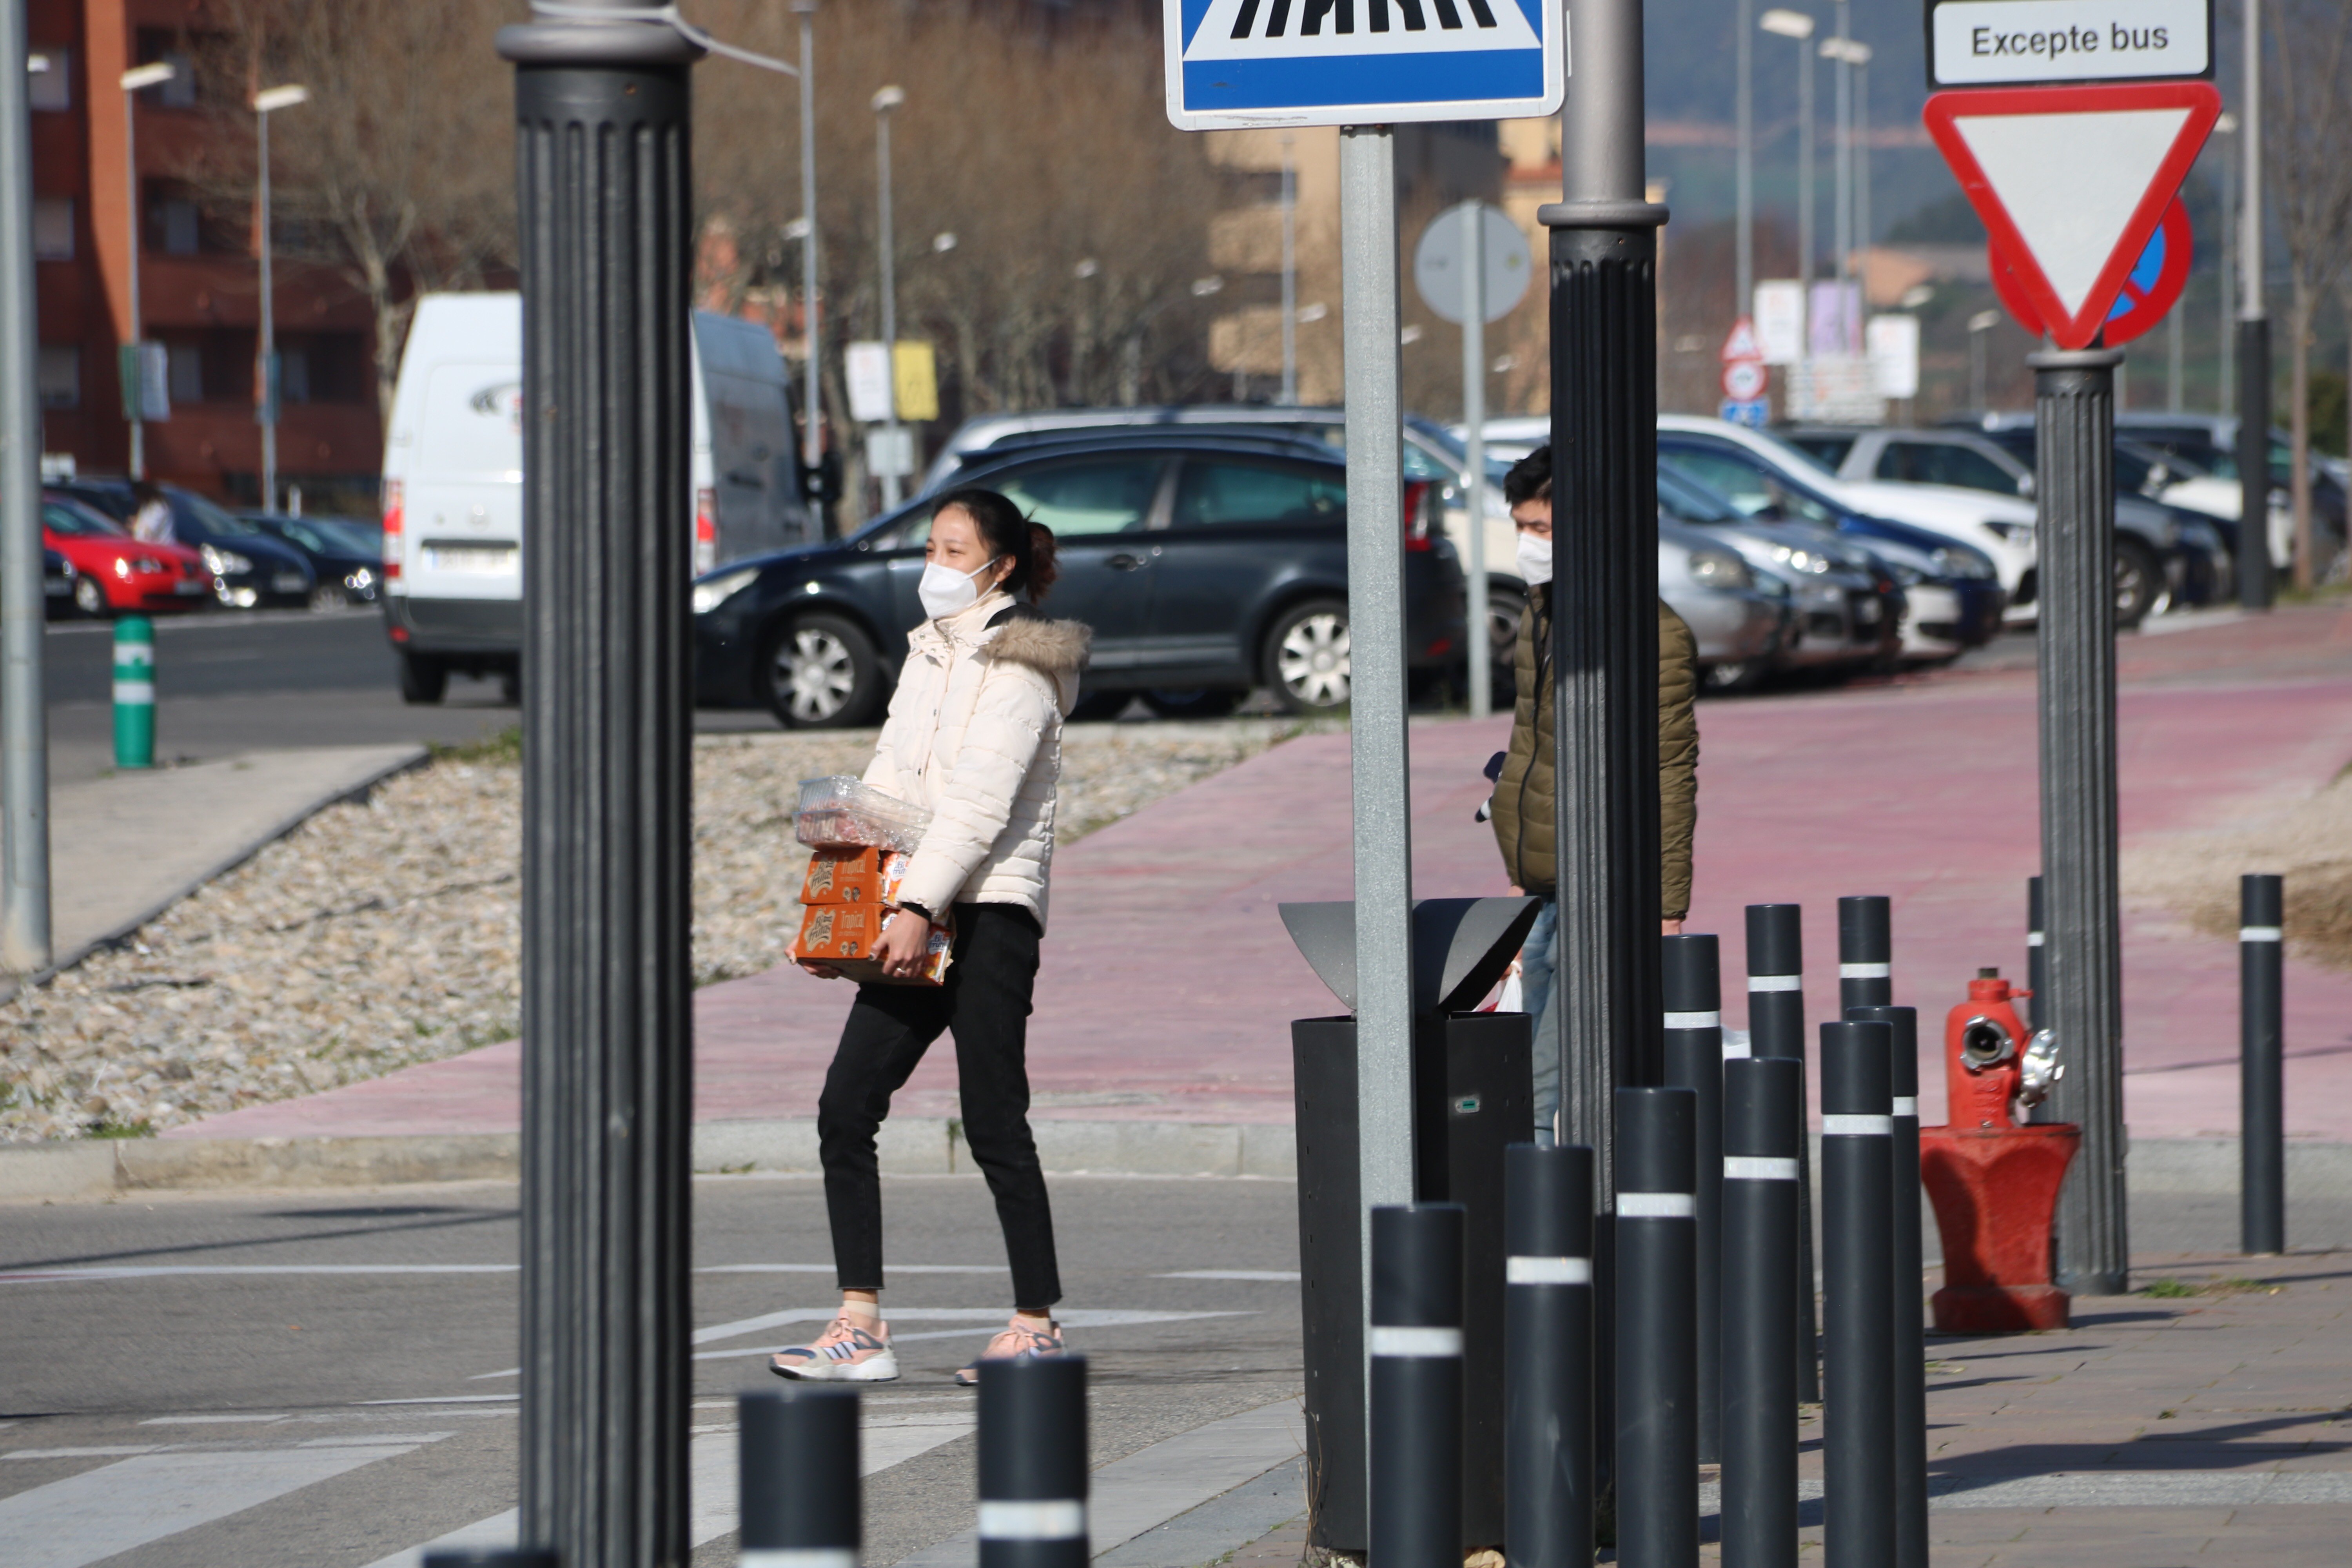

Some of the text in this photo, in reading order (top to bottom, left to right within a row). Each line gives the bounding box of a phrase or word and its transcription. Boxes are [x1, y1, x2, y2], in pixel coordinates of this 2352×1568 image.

[1971, 22, 2169, 61] Excepte bus
[842, 855, 866, 876] Tropical
[893, 866, 906, 875] frut
[841, 909, 866, 930] Tropical
